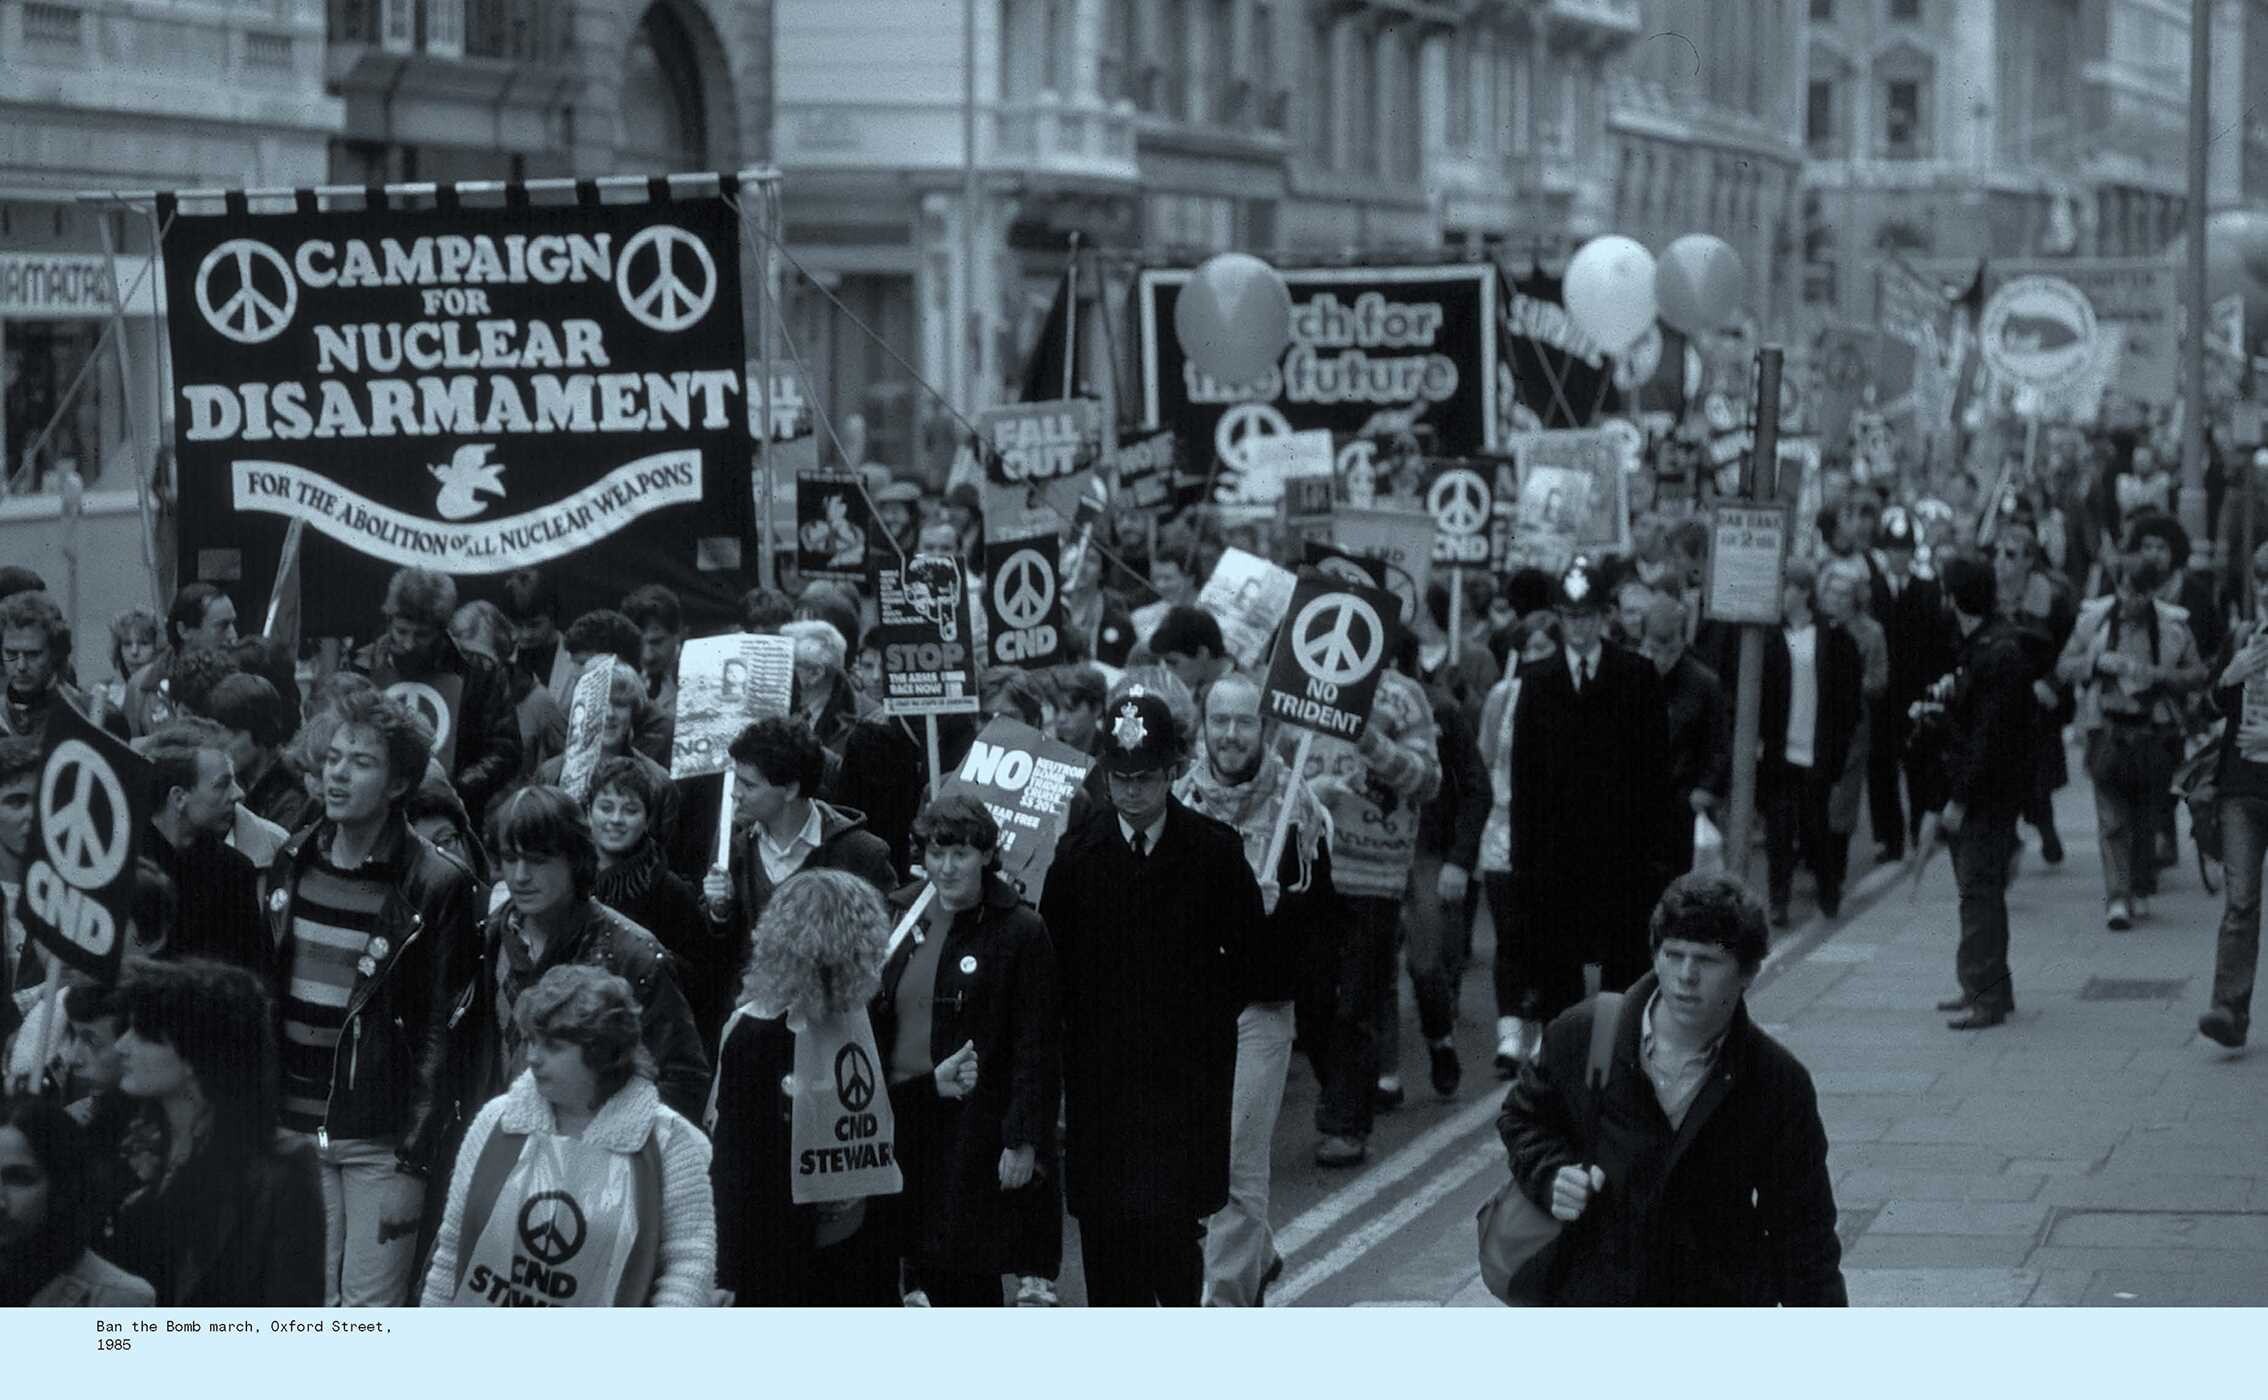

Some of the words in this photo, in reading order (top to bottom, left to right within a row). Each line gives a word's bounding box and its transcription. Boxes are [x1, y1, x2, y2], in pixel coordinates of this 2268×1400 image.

[295, 233, 613, 288] CAMPAIGN
[421, 288, 491, 316] FOR
[1354, 292, 1443, 347] for
[313, 319, 611, 374] NUCLEAR
[1284, 345, 1459, 404] future
[182, 369, 740, 442] DISARMAMENT
[247, 472, 291, 497] FOR
[295, 480, 338, 517] THE
[338, 502, 449, 556] ABOLITION
[464, 543, 497, 559] ALL
[499, 506, 596, 556] NUCLEAR
[596, 462, 695, 517] WEAPONS
[886, 642, 965, 672] STOP
[995, 624, 1058, 663] CND
[888, 673, 907, 683] THE
[914, 683, 942, 694] NOW
[1306, 677, 1338, 704] NO
[1271, 689, 1362, 736] TRIDENT
[960, 740, 1033, 792] NO
[1035, 757, 1086, 780] NEUTRON
[1014, 812, 1041, 830] FREE
[27, 861, 116, 956] CND
[835, 1113, 878, 1142] CND
[511, 1255, 577, 1299] CND
